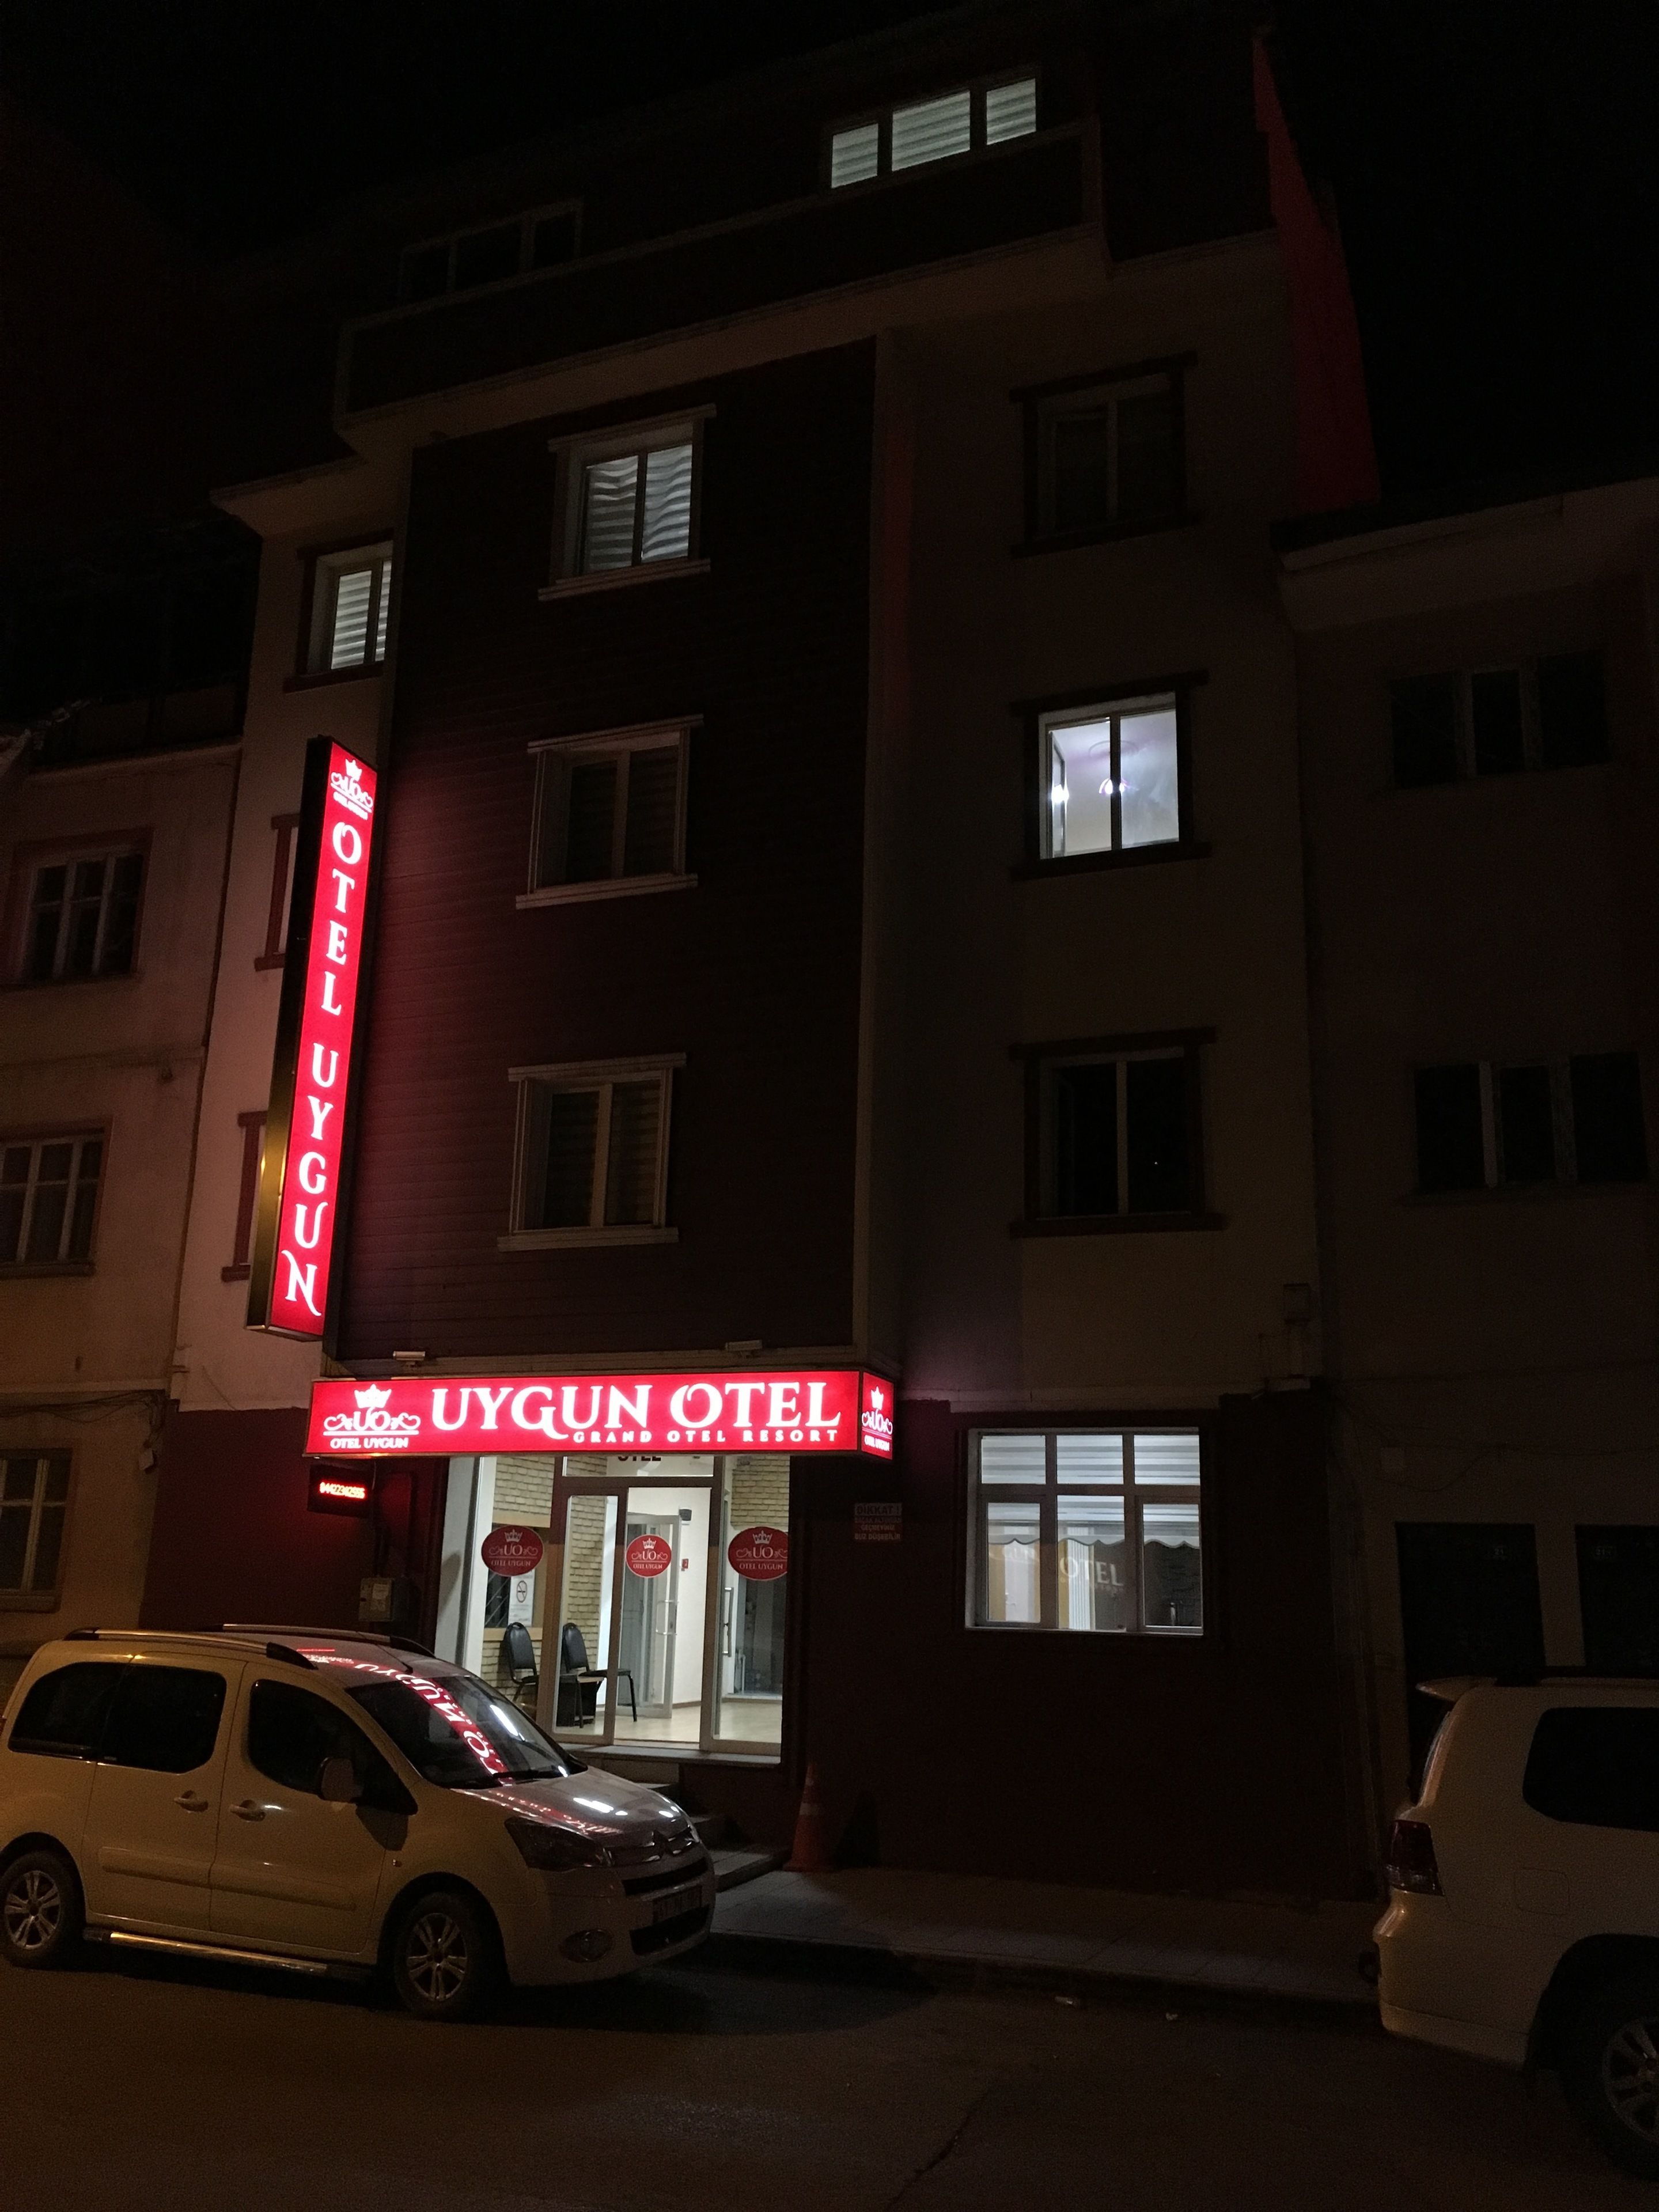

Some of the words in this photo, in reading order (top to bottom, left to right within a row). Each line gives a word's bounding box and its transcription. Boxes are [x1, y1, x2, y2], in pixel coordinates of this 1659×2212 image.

[321, 822, 362, 1016] OTEL
[281, 1043, 339, 1317] UYGUN
[432, 1385, 653, 1440] UYGUN
[670, 1382, 841, 1429] OTEL
[573, 1430, 652, 1443] GRAND
[666, 1430, 726, 1443] OTEL
[743, 1429, 838, 1442] RESORT
[330, 1438, 362, 1449] OTEL
[363, 1437, 410, 1449] UYGUN
